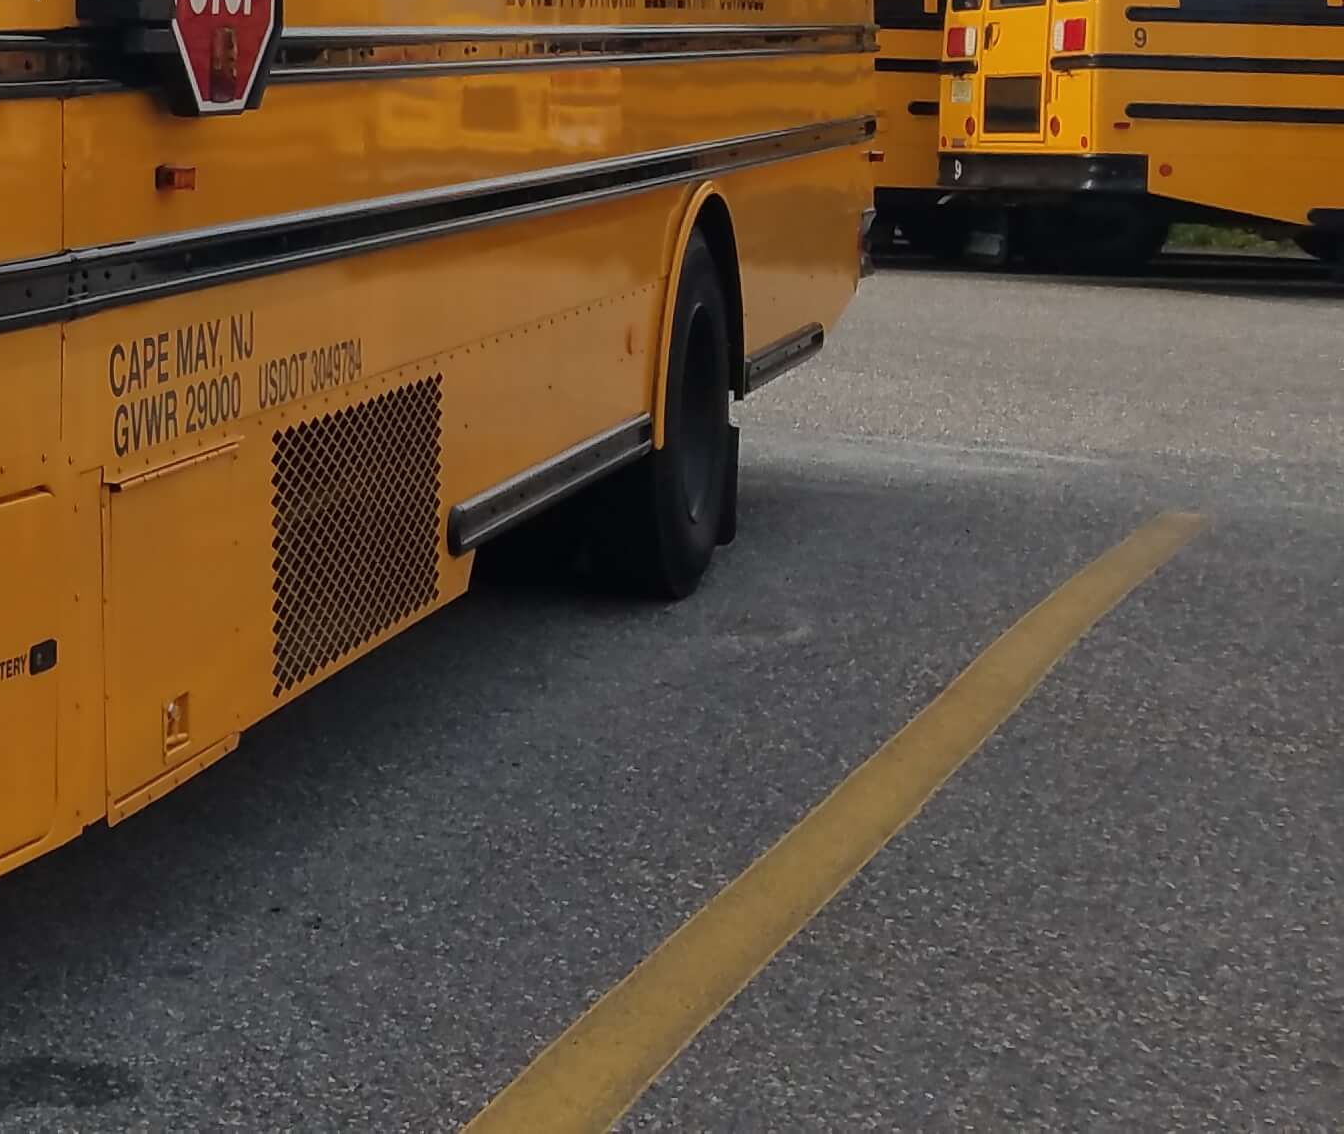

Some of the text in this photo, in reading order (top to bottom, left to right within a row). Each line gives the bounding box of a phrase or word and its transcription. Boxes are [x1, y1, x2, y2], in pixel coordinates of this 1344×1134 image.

[1134, 26, 1147, 48] 9
[954, 159, 963, 180] 9
[108, 311, 255, 398] CAPE MAY, NJ
[258, 352, 307, 409] USDOT
[112, 374, 241, 458] GVWR 29000
